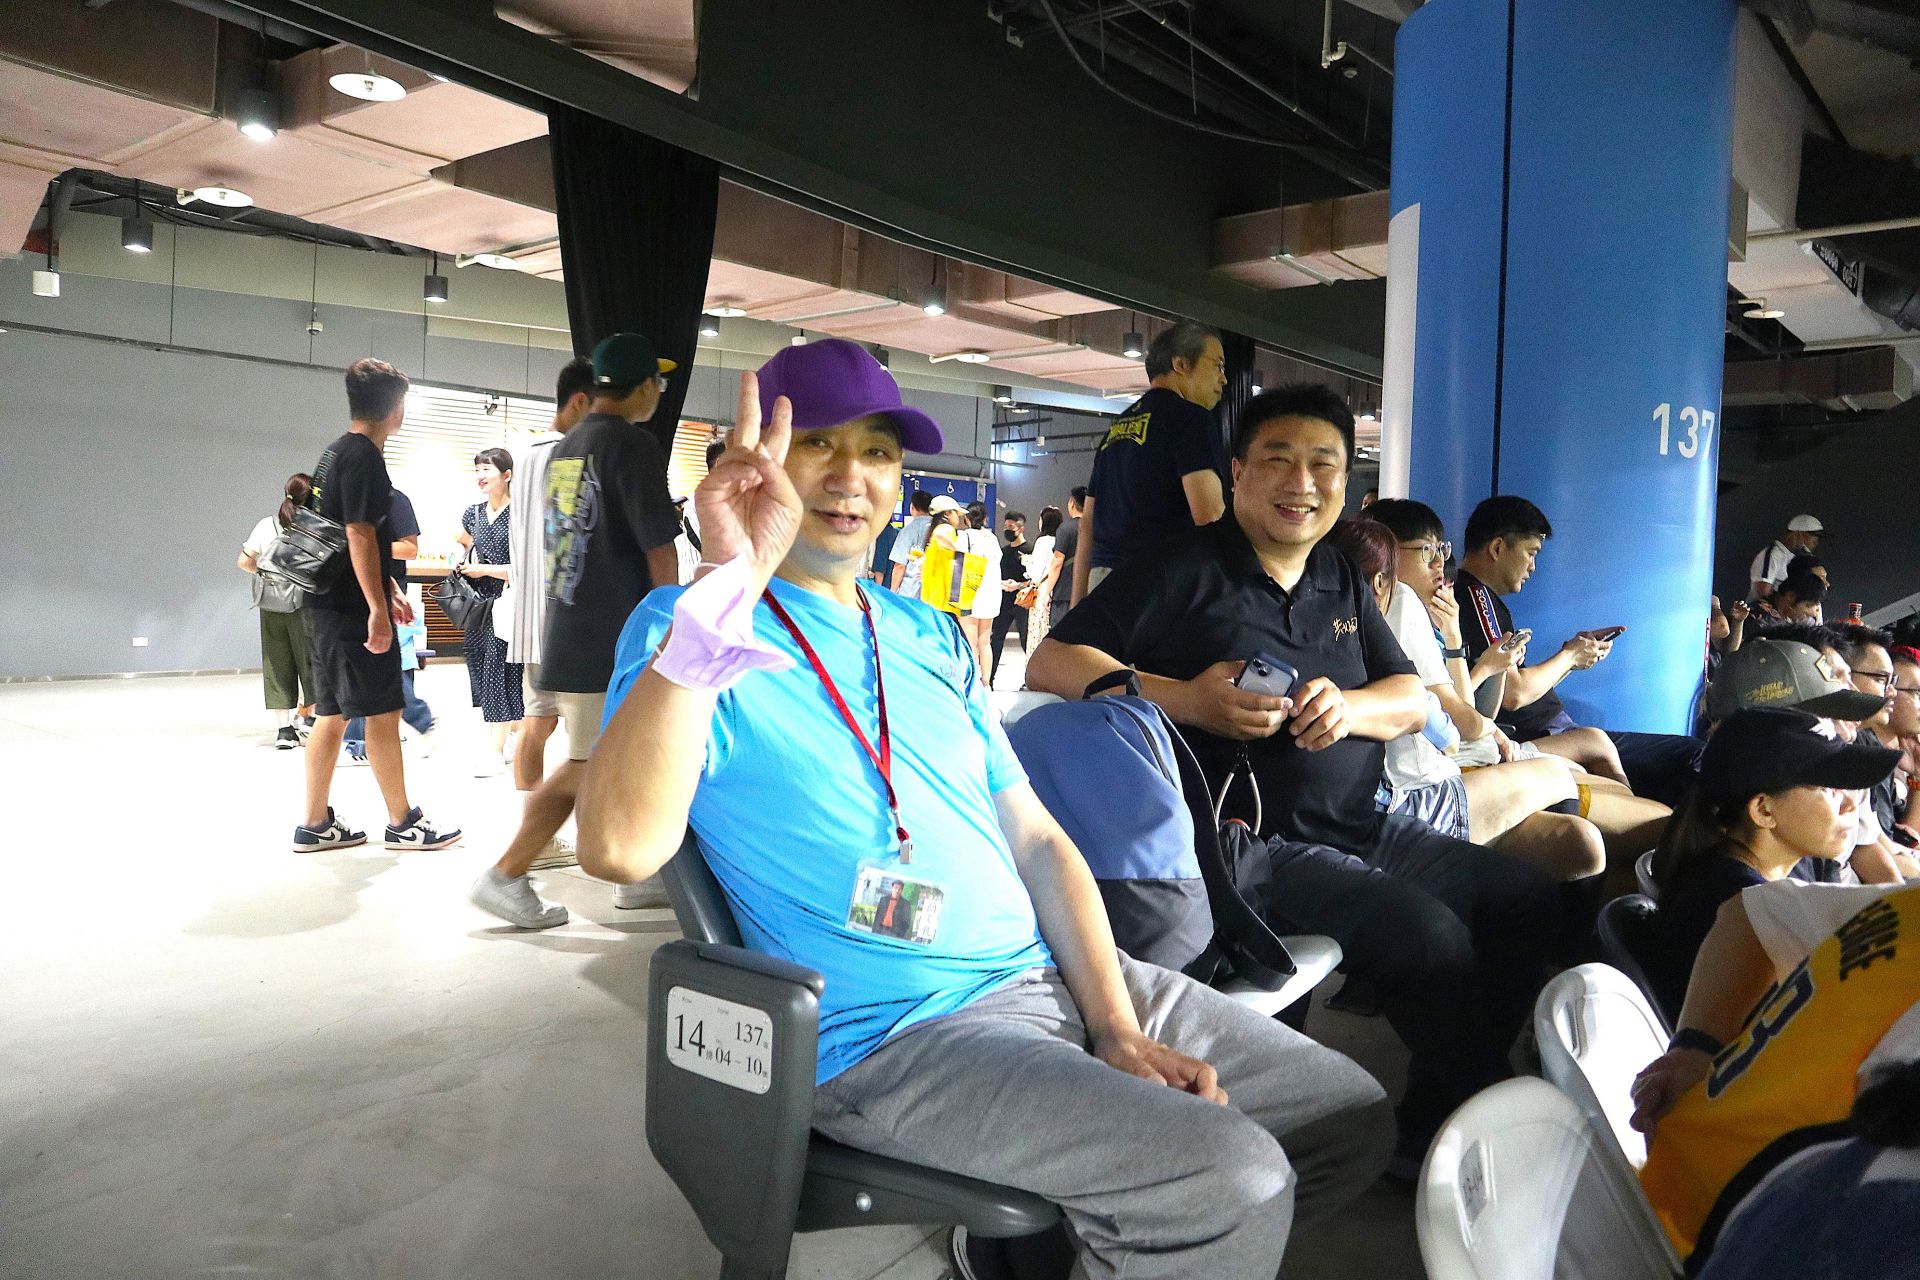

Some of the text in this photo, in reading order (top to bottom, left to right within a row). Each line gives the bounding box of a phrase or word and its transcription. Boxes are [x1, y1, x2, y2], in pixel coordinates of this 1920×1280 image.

[1652, 402, 1715, 460] 137
[674, 1014, 706, 1057] 14
[735, 1021, 764, 1046] 137
[715, 1047, 731, 1066] 04
[746, 1056, 762, 1075] 10
